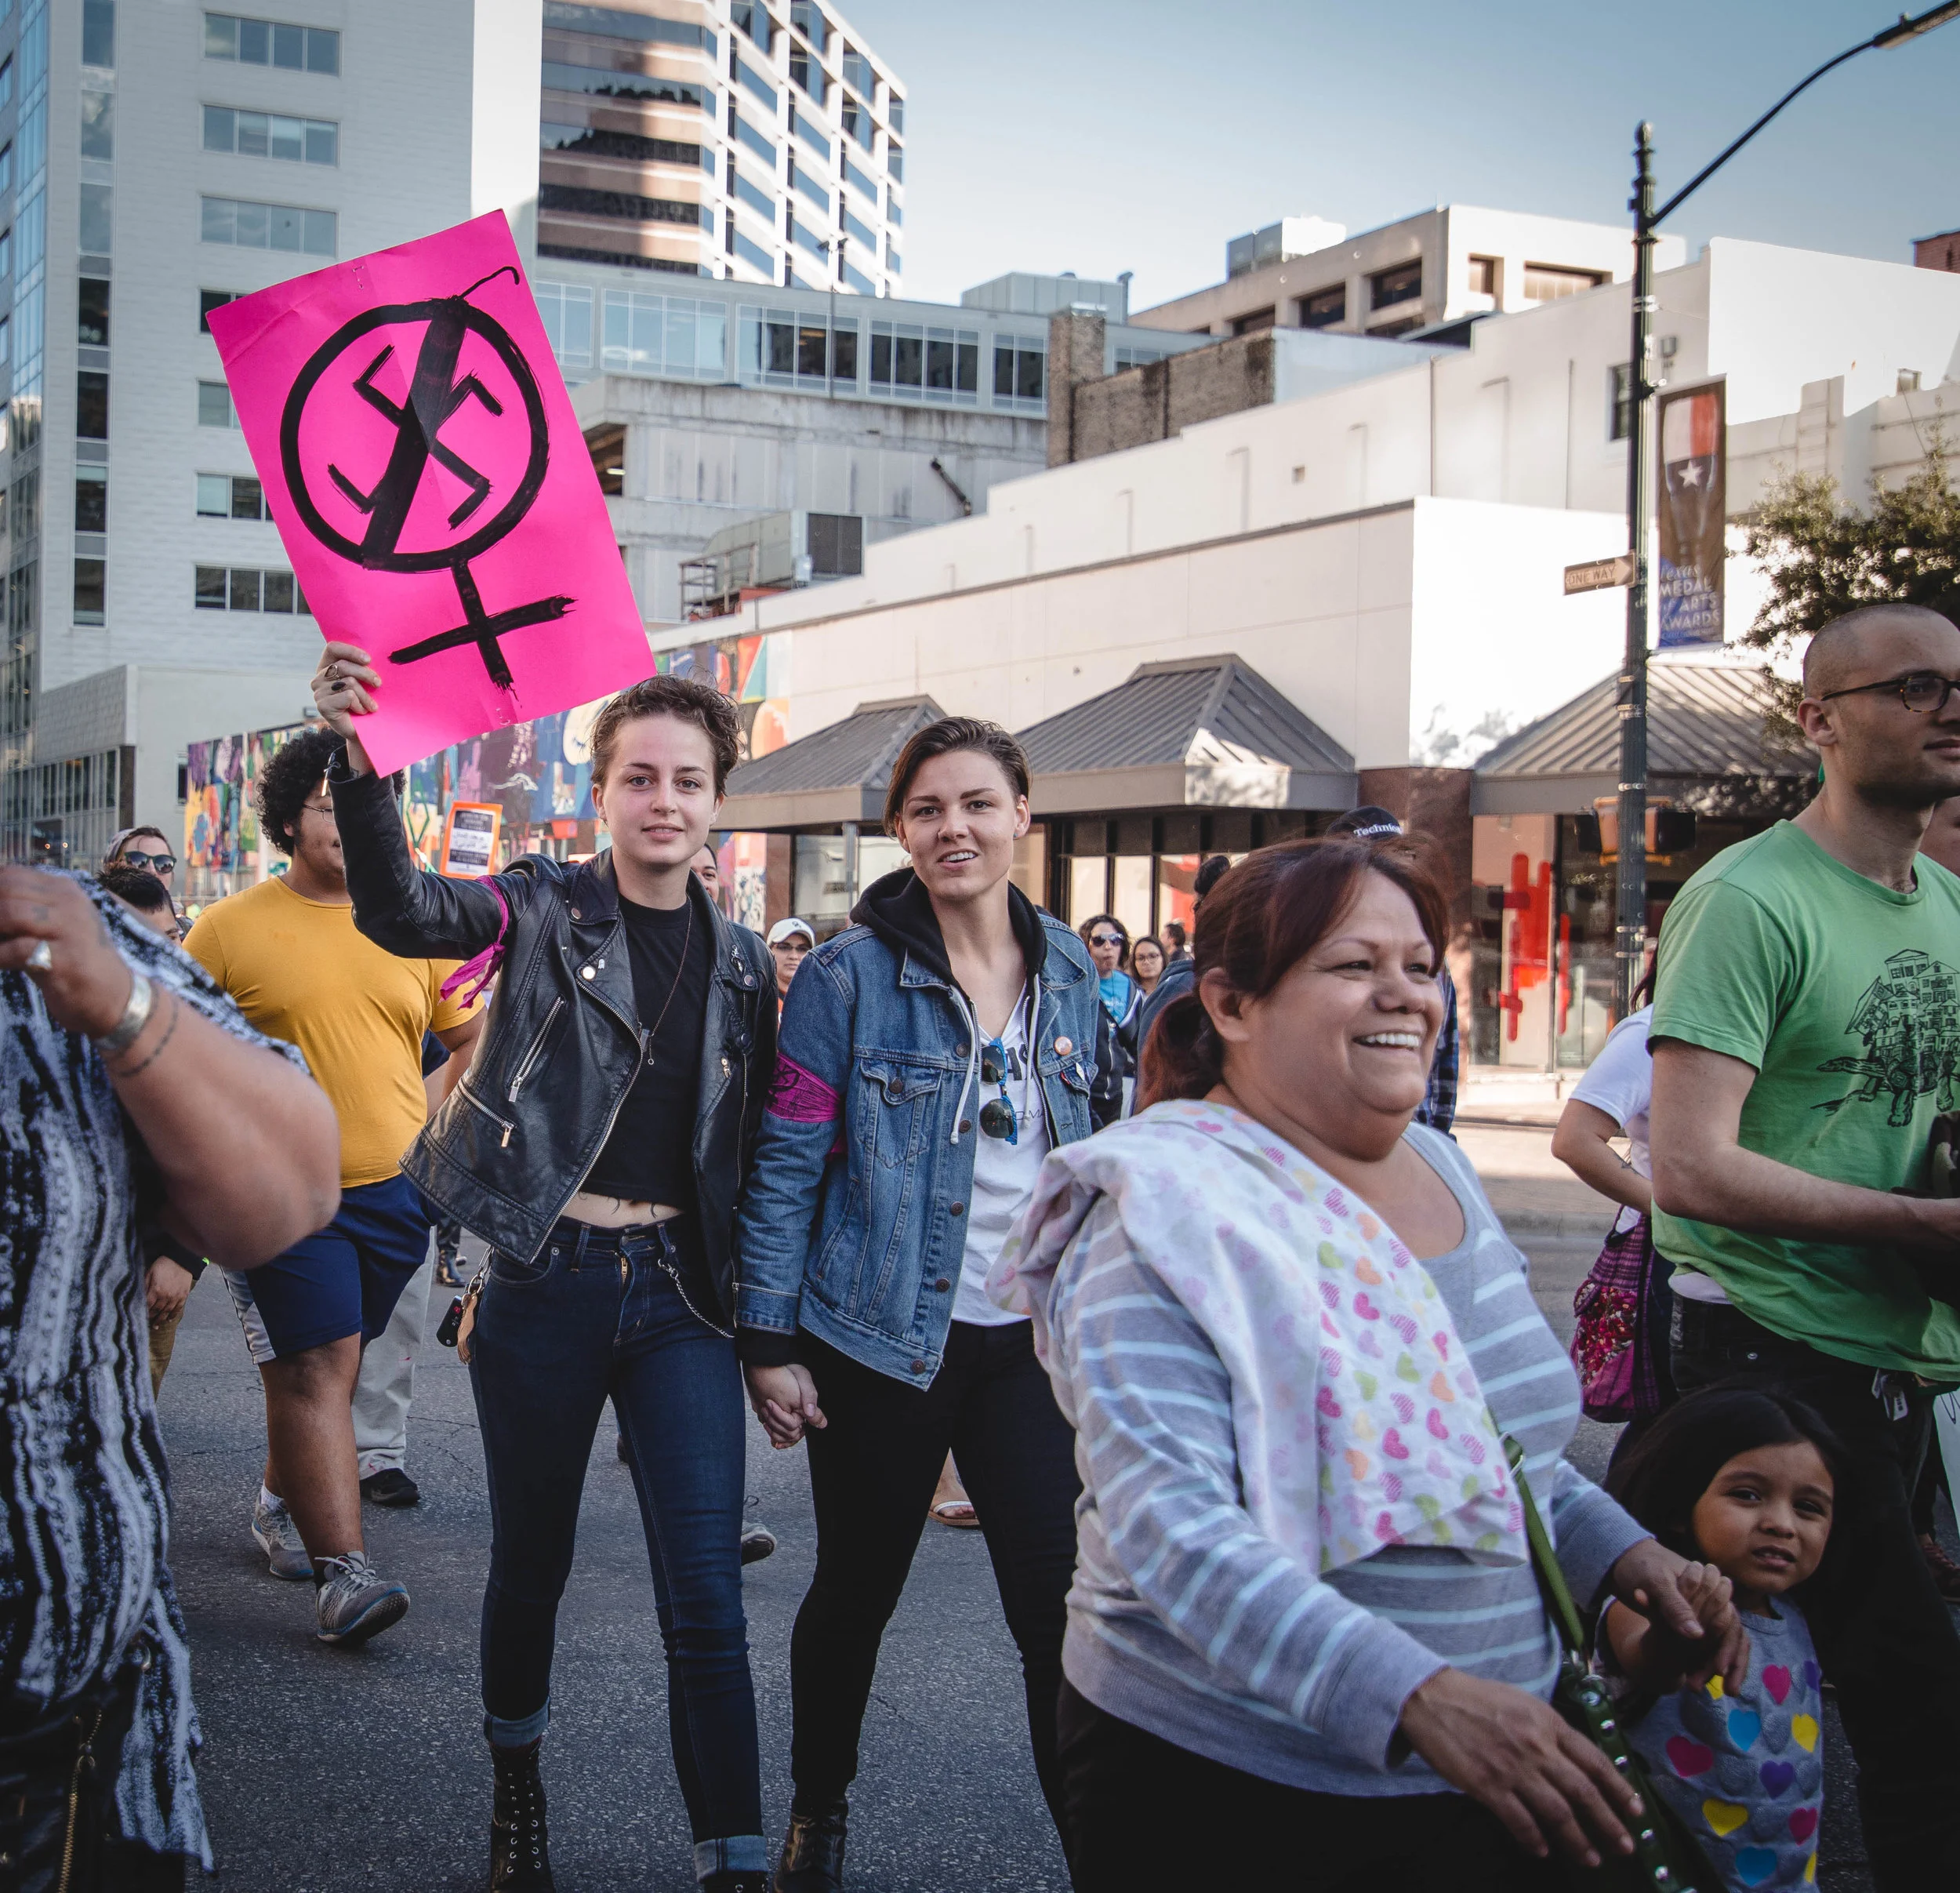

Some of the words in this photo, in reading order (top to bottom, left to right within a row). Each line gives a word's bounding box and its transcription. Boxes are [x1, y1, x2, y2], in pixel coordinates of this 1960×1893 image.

[1570, 570, 1591, 585] ONE
[1592, 563, 1616, 581] WAY
[1660, 577, 1712, 597] MEDAL
[1679, 593, 1719, 612] ARTS
[1662, 609, 1719, 630] AWARDS
